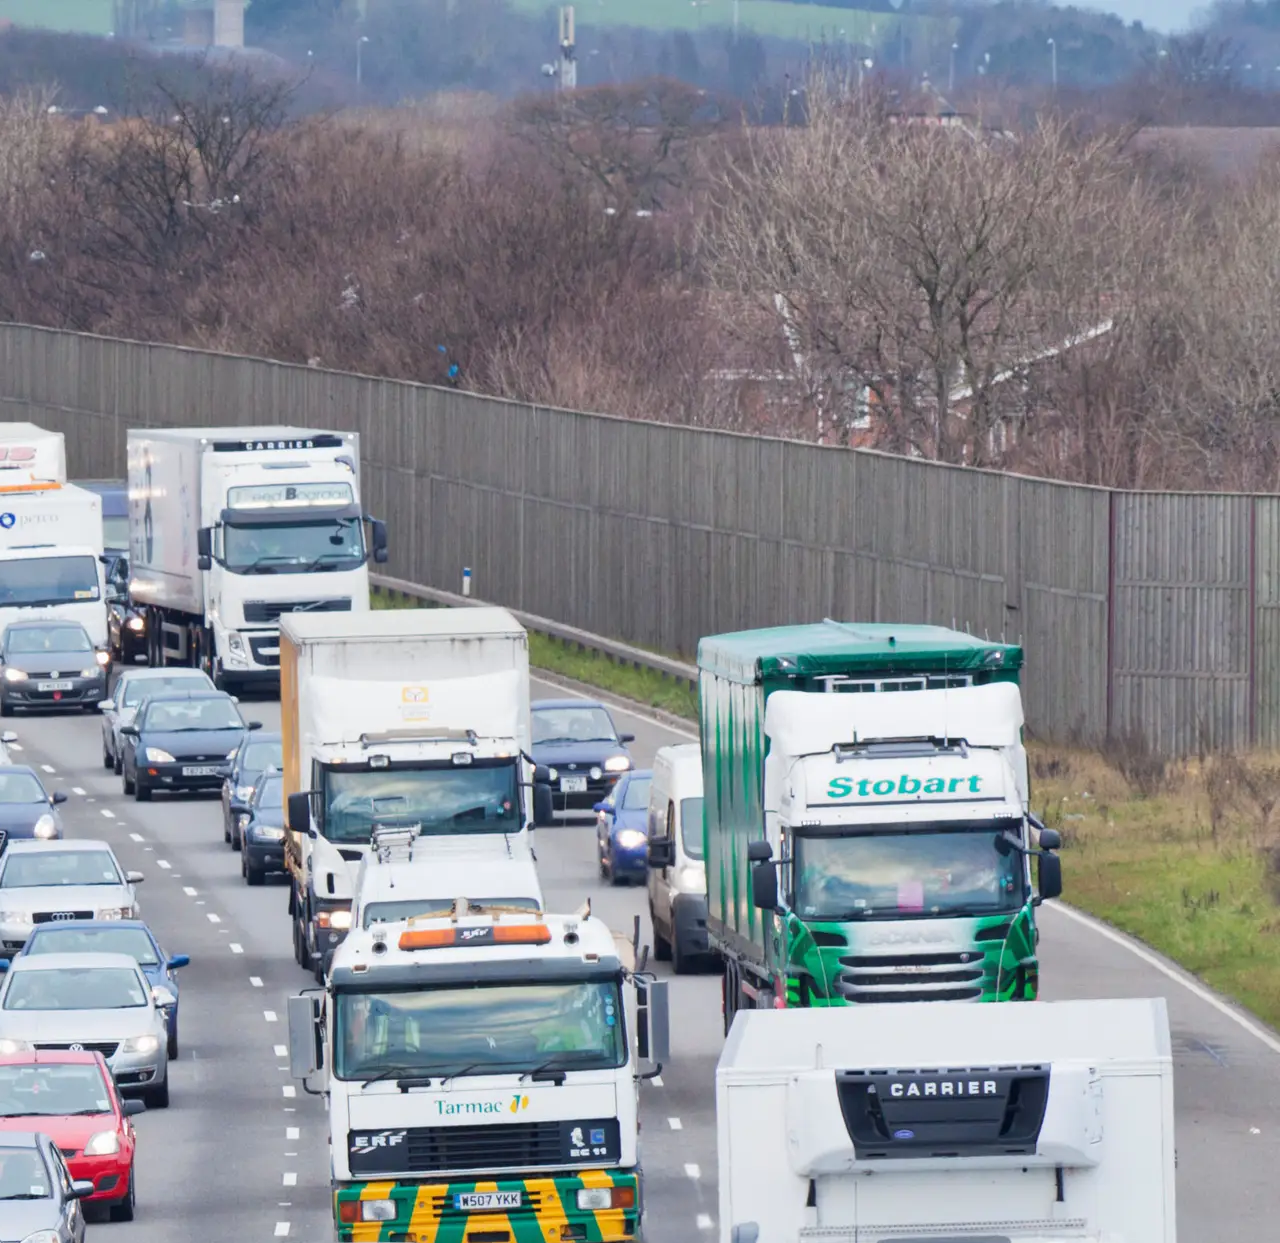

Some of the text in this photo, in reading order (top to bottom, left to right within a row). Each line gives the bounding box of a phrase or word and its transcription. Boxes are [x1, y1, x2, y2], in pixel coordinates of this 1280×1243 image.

[245, 440, 314, 451] CARRIER
[826, 774, 984, 799] Stobart
[890, 1080, 997, 1097] CARRIER
[434, 1100, 504, 1115] Tarmac
[355, 1135, 405, 1148] ERF
[461, 1193, 519, 1208] W507 YKK
